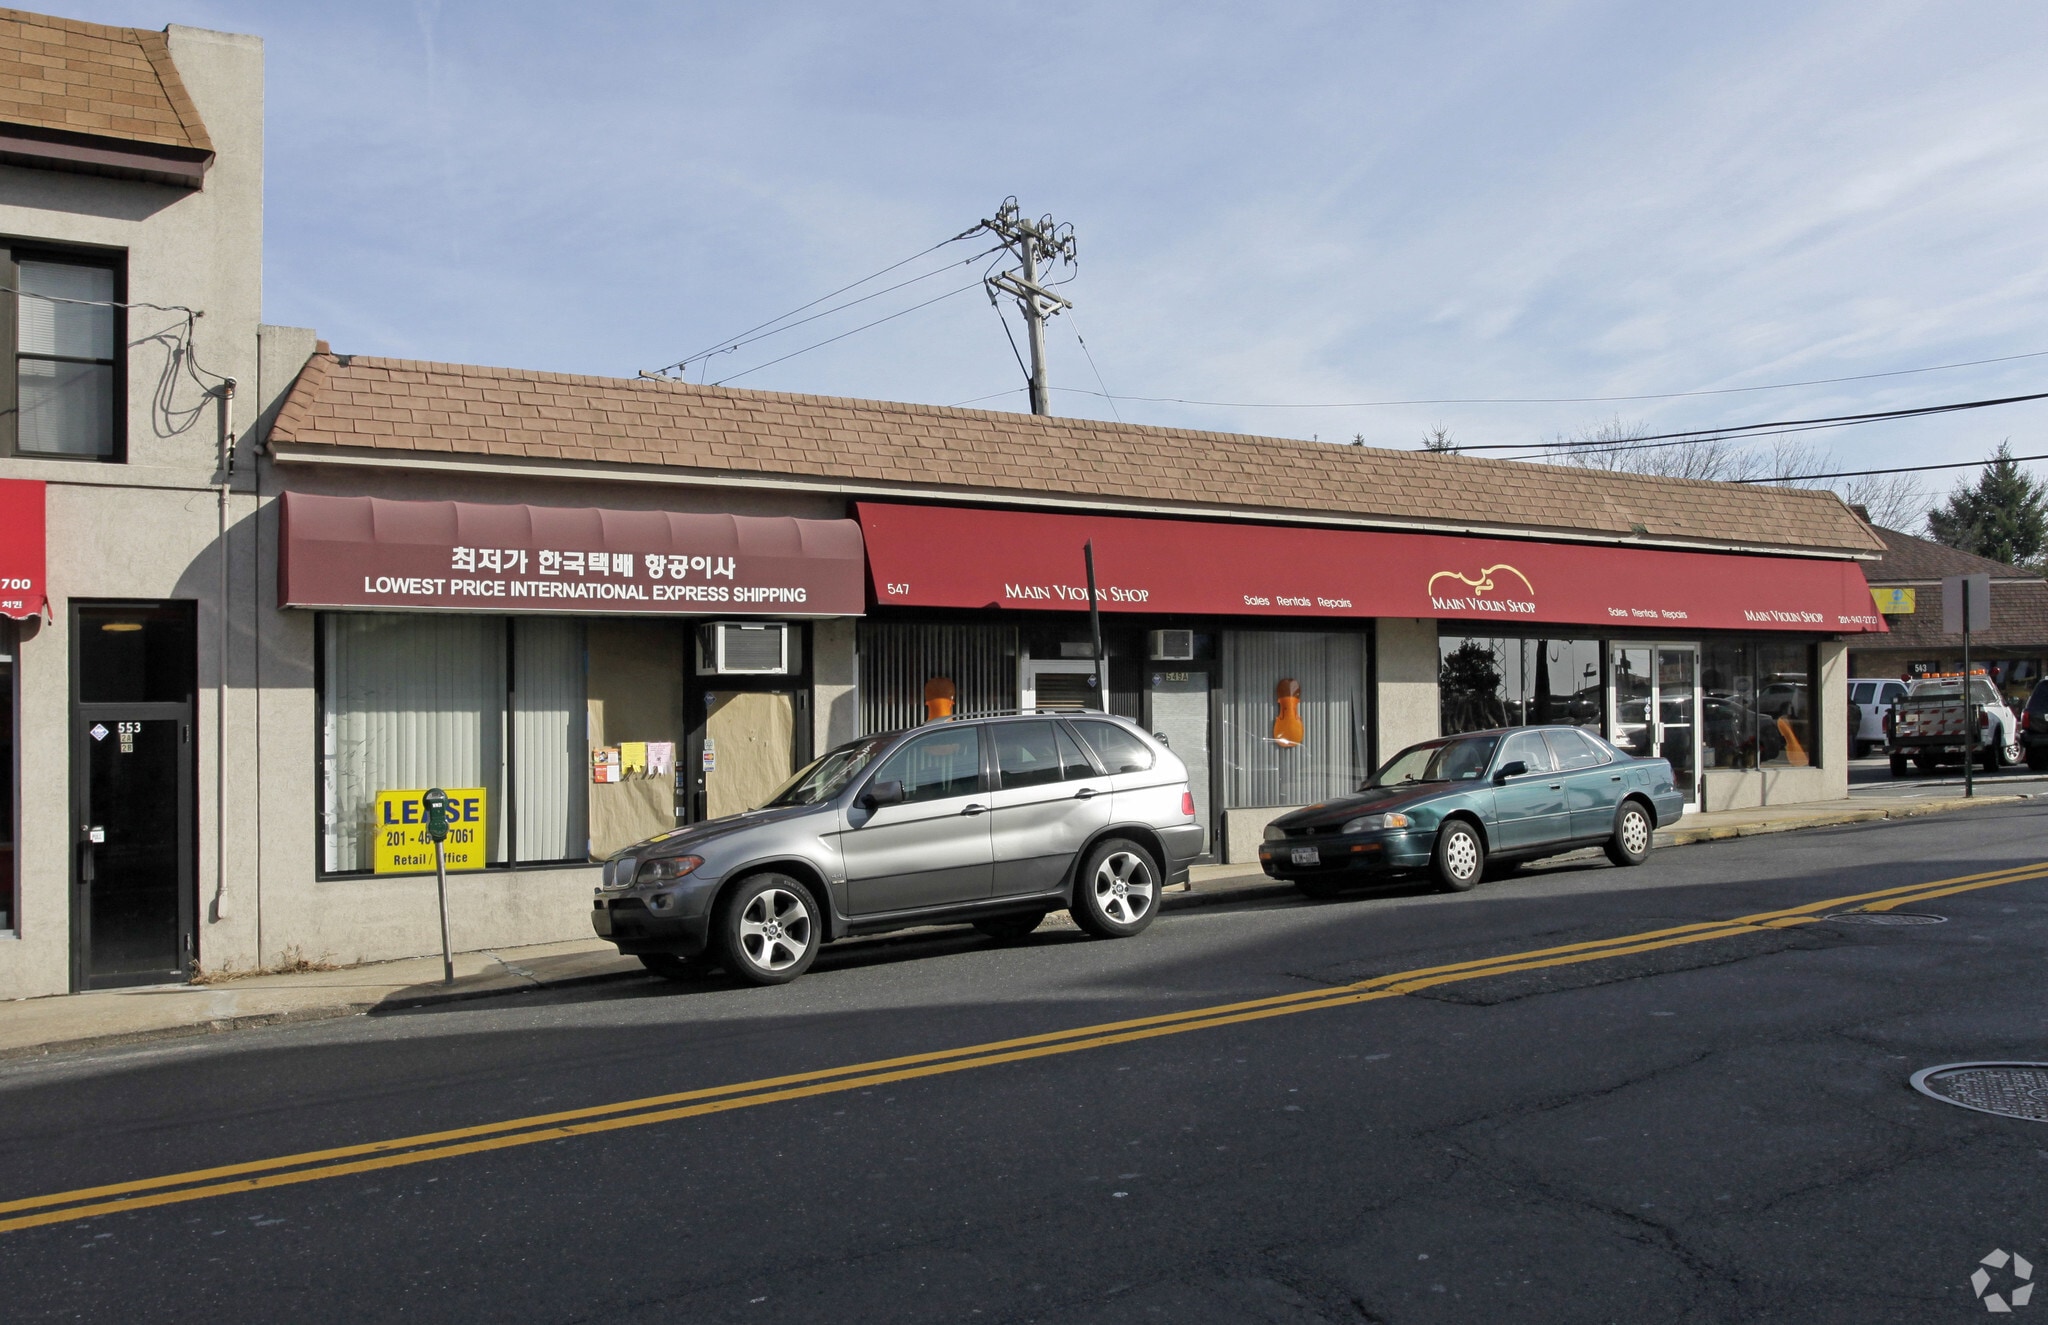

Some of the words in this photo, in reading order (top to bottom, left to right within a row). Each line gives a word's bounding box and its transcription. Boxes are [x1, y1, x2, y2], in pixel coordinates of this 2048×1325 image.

[451, 546, 529, 574] 최저가
[538, 550, 633, 578] 한국택배
[645, 553, 736, 580] 항공이사
[1, 578, 32, 590] 700
[364, 576, 446, 595] LOWEST
[450, 579, 506, 596] PRICE
[510, 581, 649, 600] INTERNATIONAL
[653, 585, 729, 602] EXPRESS
[733, 587, 807, 603] SHIPPING
[887, 583, 910, 595] 547
[1005, 583, 1051, 599] MAIN
[1110, 586, 1149, 603] SHOP
[1243, 595, 1270, 606] Sales
[1276, 596, 1312, 608] Rentals
[1317, 597, 1353, 609] Repairs
[1431, 597, 1466, 610] MAIN
[1466, 597, 1507, 612] VIOLIN
[1508, 599, 1536, 613] SHOP
[1607, 607, 1628, 617] Sales
[1631, 608, 1659, 618] Rentals
[1661, 609, 1688, 619] Repairs
[1743, 609, 1771, 622] MAIN
[1914, 664, 1928, 672] 543
[117, 722, 142, 733] 553
[386, 831, 406, 847] 201
[417, 830, 432, 845] 46
[449, 828, 474, 844] 7061
[393, 853, 426, 866] Retail
[443, 852, 468, 863] ffice
